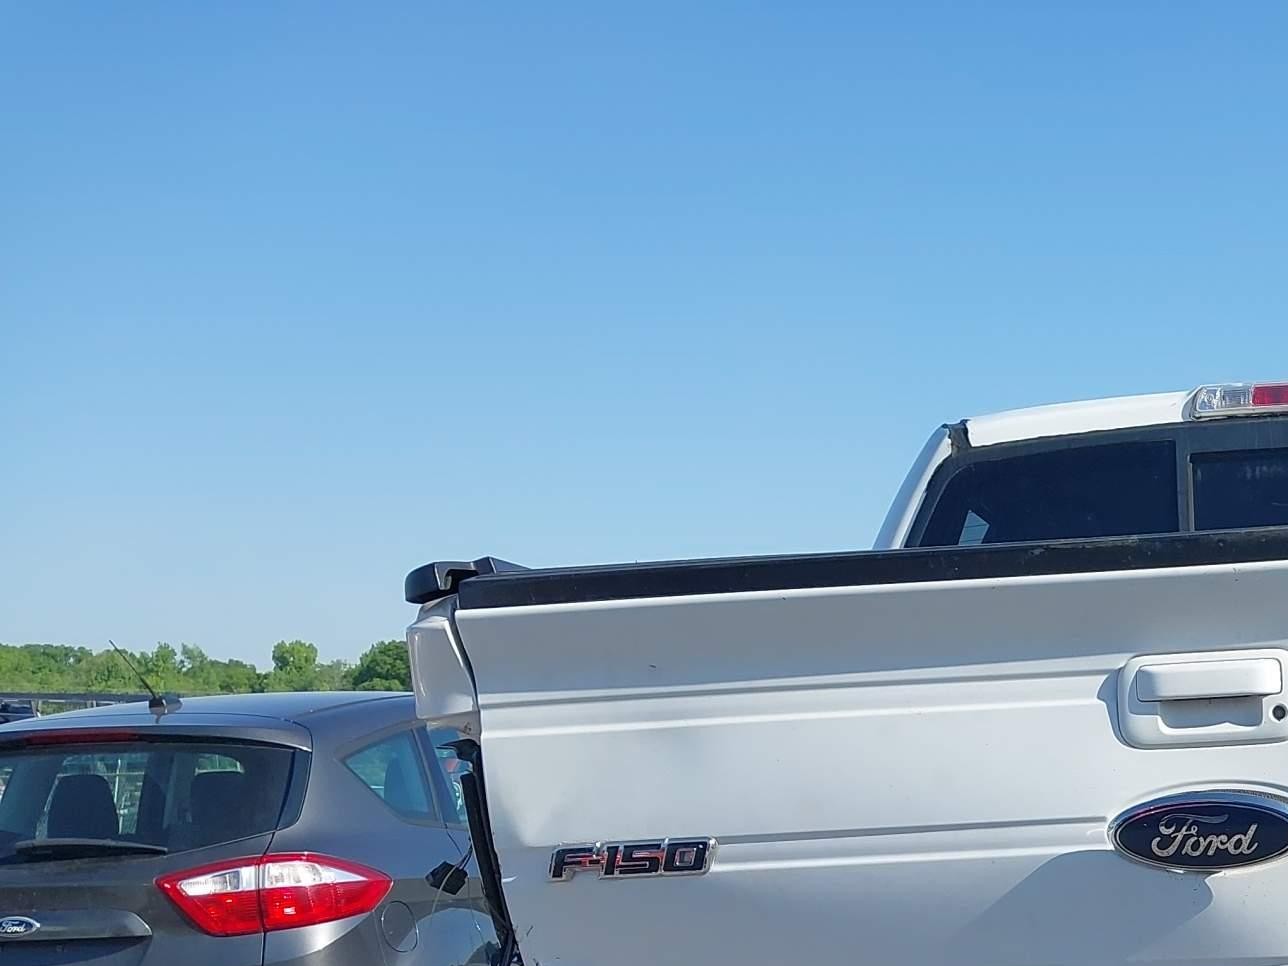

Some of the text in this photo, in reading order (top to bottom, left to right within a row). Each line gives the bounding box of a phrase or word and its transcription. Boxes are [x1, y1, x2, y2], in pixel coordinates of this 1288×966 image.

[1151, 812, 1259, 857] Ford
[548, 836, 718, 882] F-150
[0, 920, 26, 933] Ford
